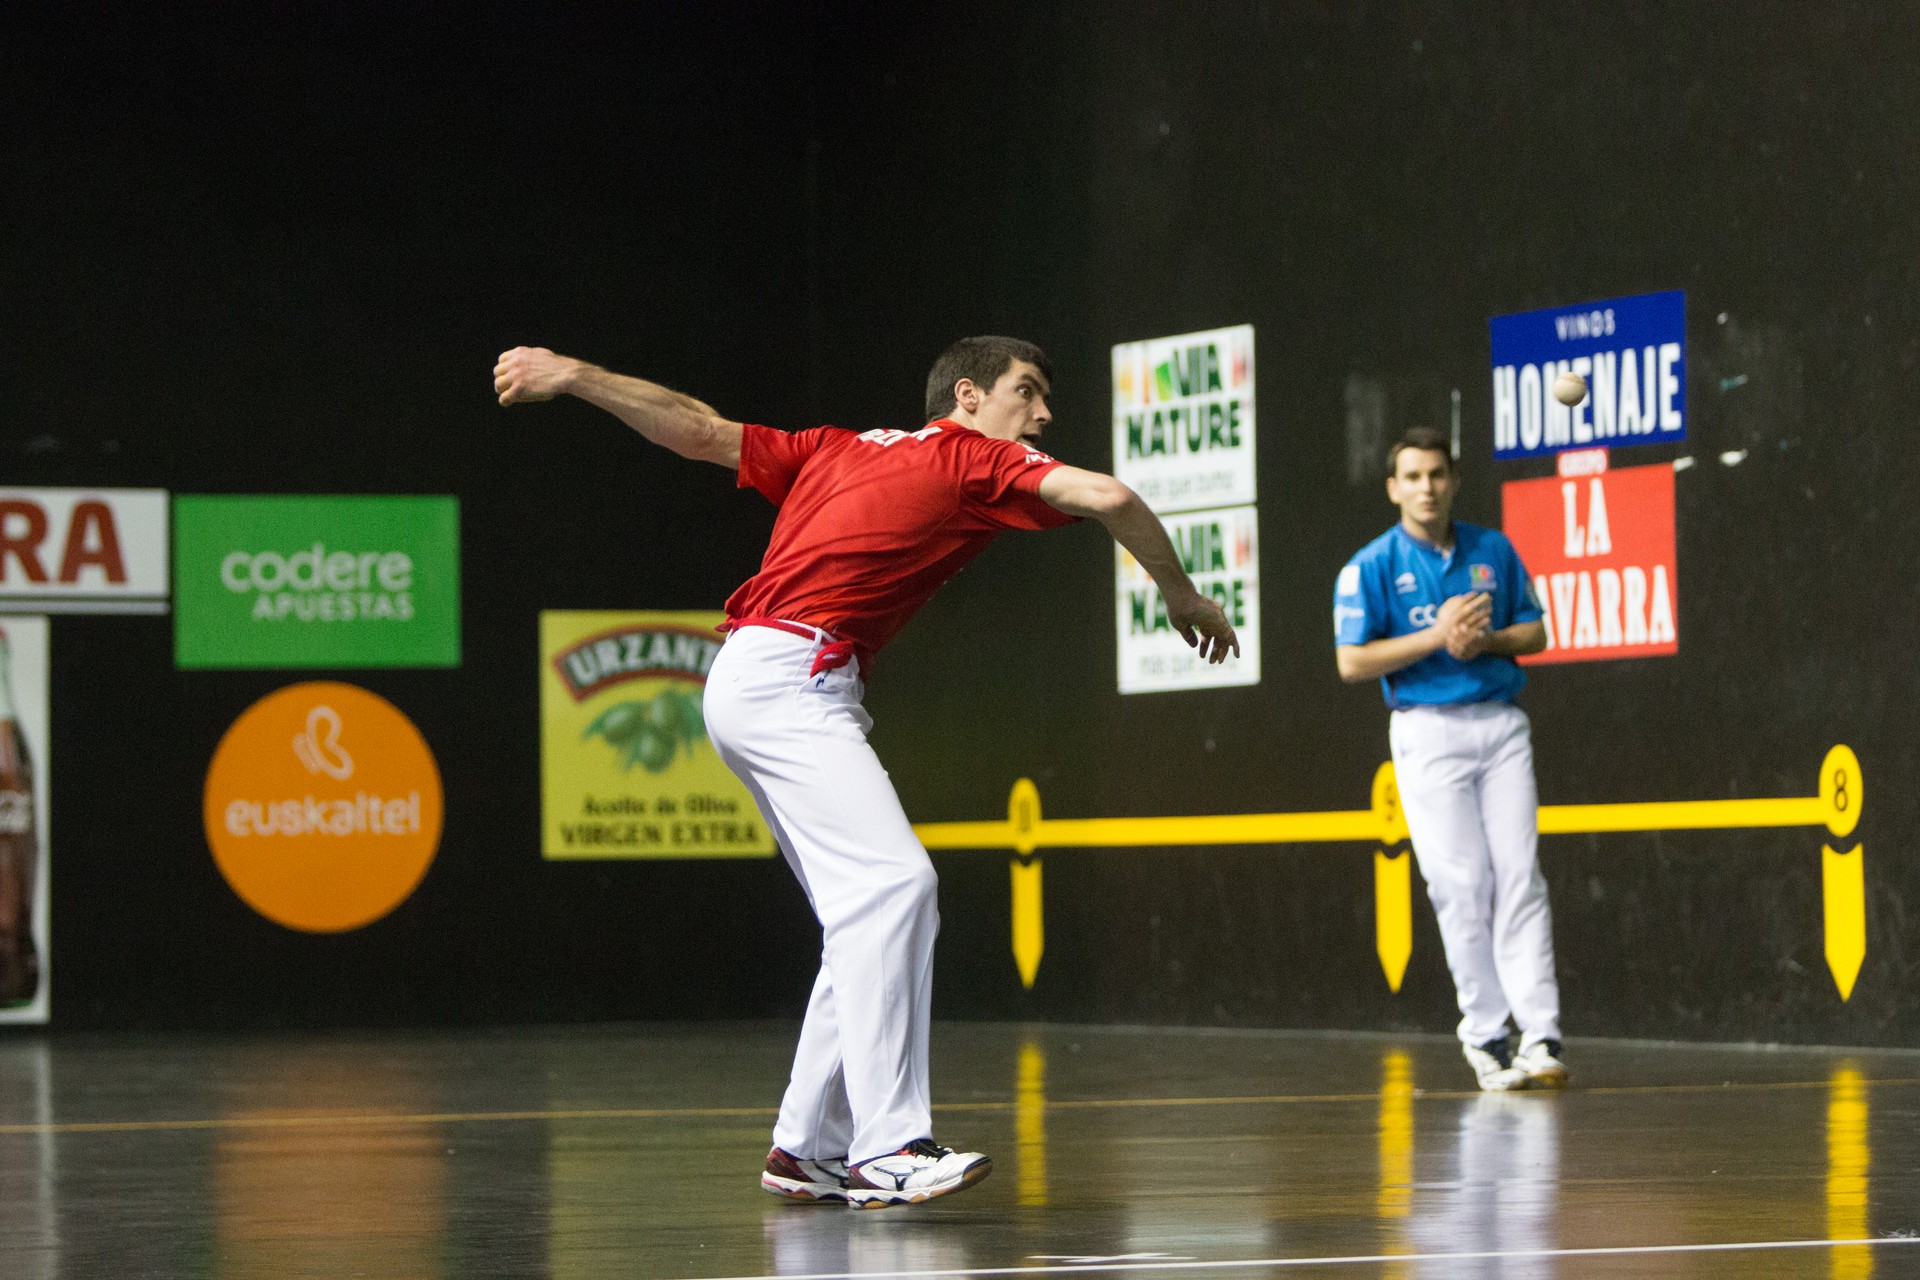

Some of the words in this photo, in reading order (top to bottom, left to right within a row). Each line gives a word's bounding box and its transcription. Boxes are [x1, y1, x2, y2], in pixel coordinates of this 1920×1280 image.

[1555, 308, 1616, 341] VINOS
[1493, 342, 1682, 451] HOMENAJE
[1127, 400, 1241, 460] NATURE
[1562, 477, 1612, 558] LA
[221, 541, 414, 593] codere
[252, 593, 415, 622] APUESTAS
[1534, 564, 1676, 651] AVARRA
[225, 791, 420, 836] euskaltel
[1833, 767, 1849, 812] 8
